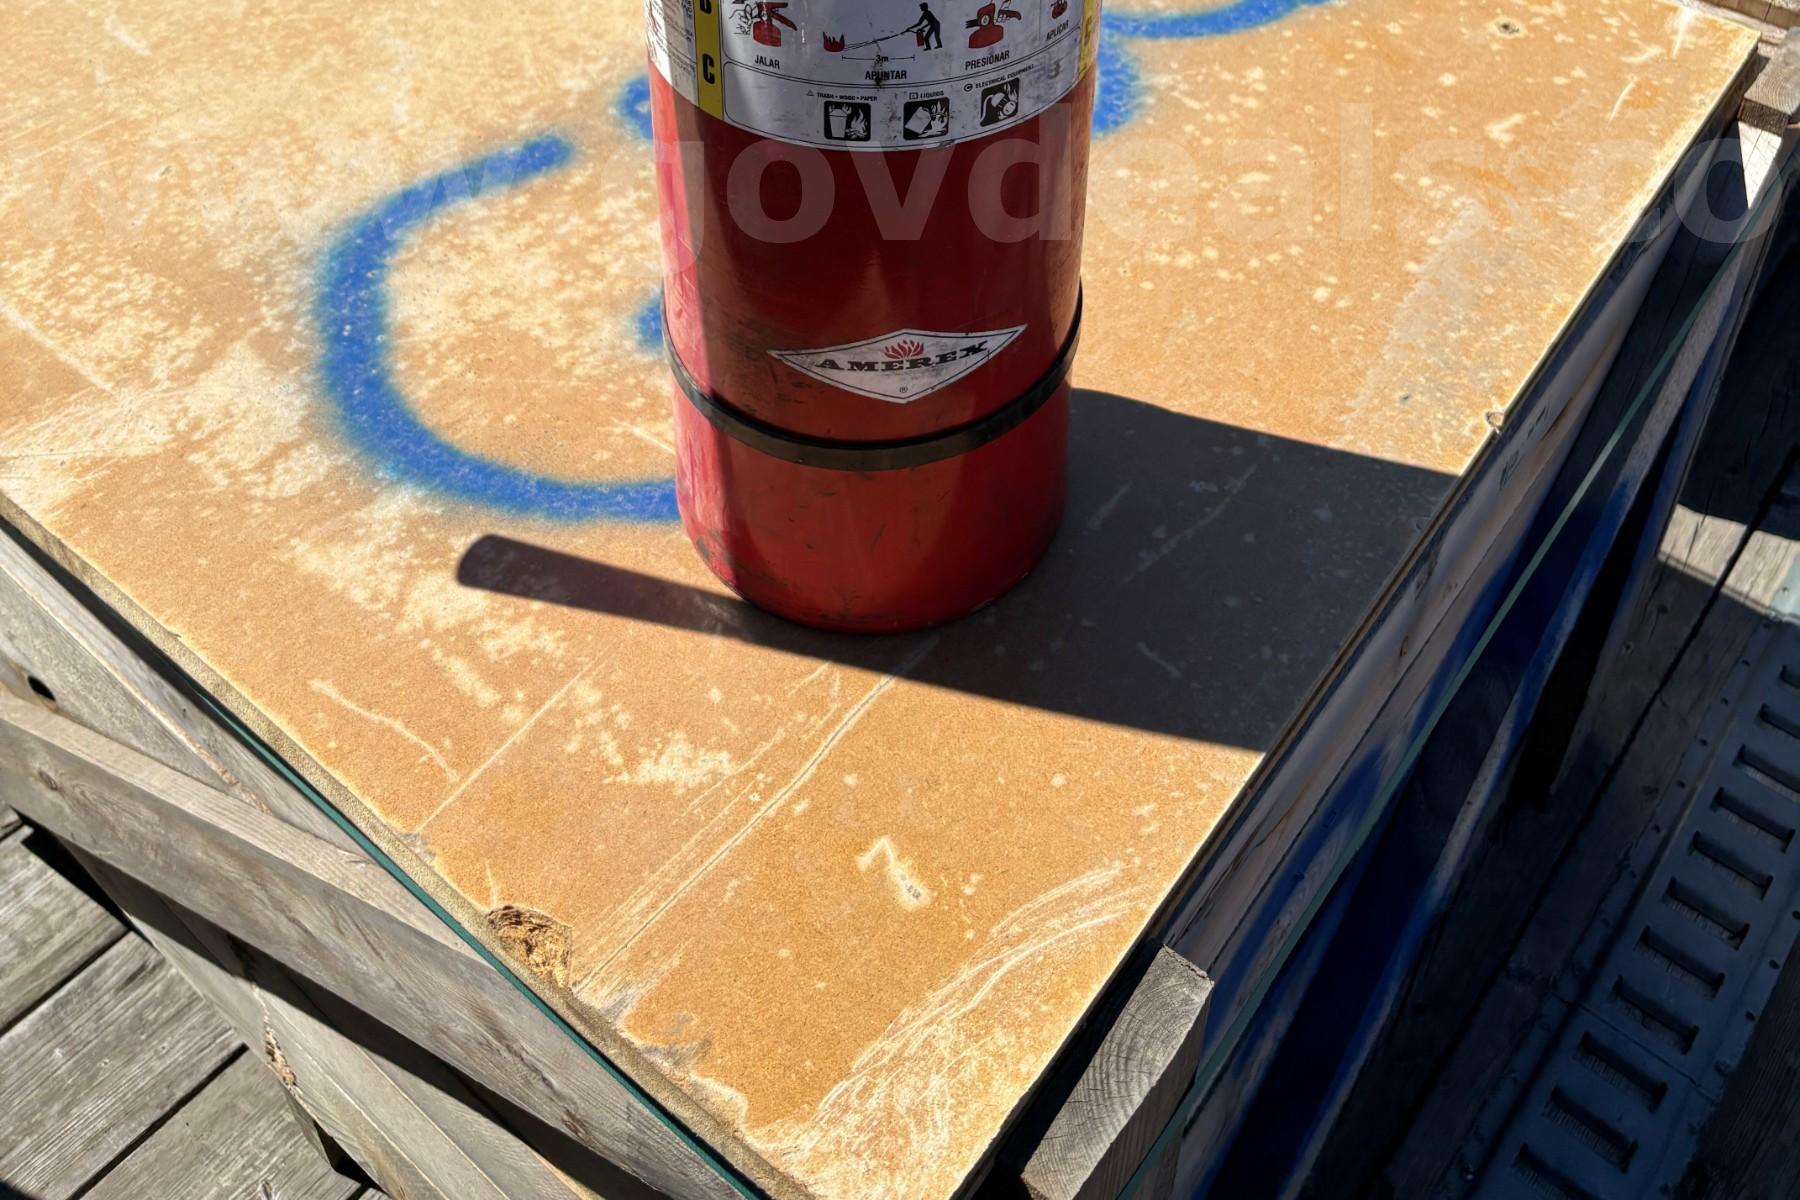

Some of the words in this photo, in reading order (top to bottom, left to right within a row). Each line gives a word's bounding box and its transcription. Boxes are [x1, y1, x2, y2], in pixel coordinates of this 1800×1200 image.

[754, 54, 781, 70] JALAR
[875, 54, 889, 63] 3m
[964, 50, 1010, 71] PRESIONAR
[702, 53, 716, 85] C
[864, 70, 907, 80] APUNTAR
[815, 339, 989, 373] AMEREX
